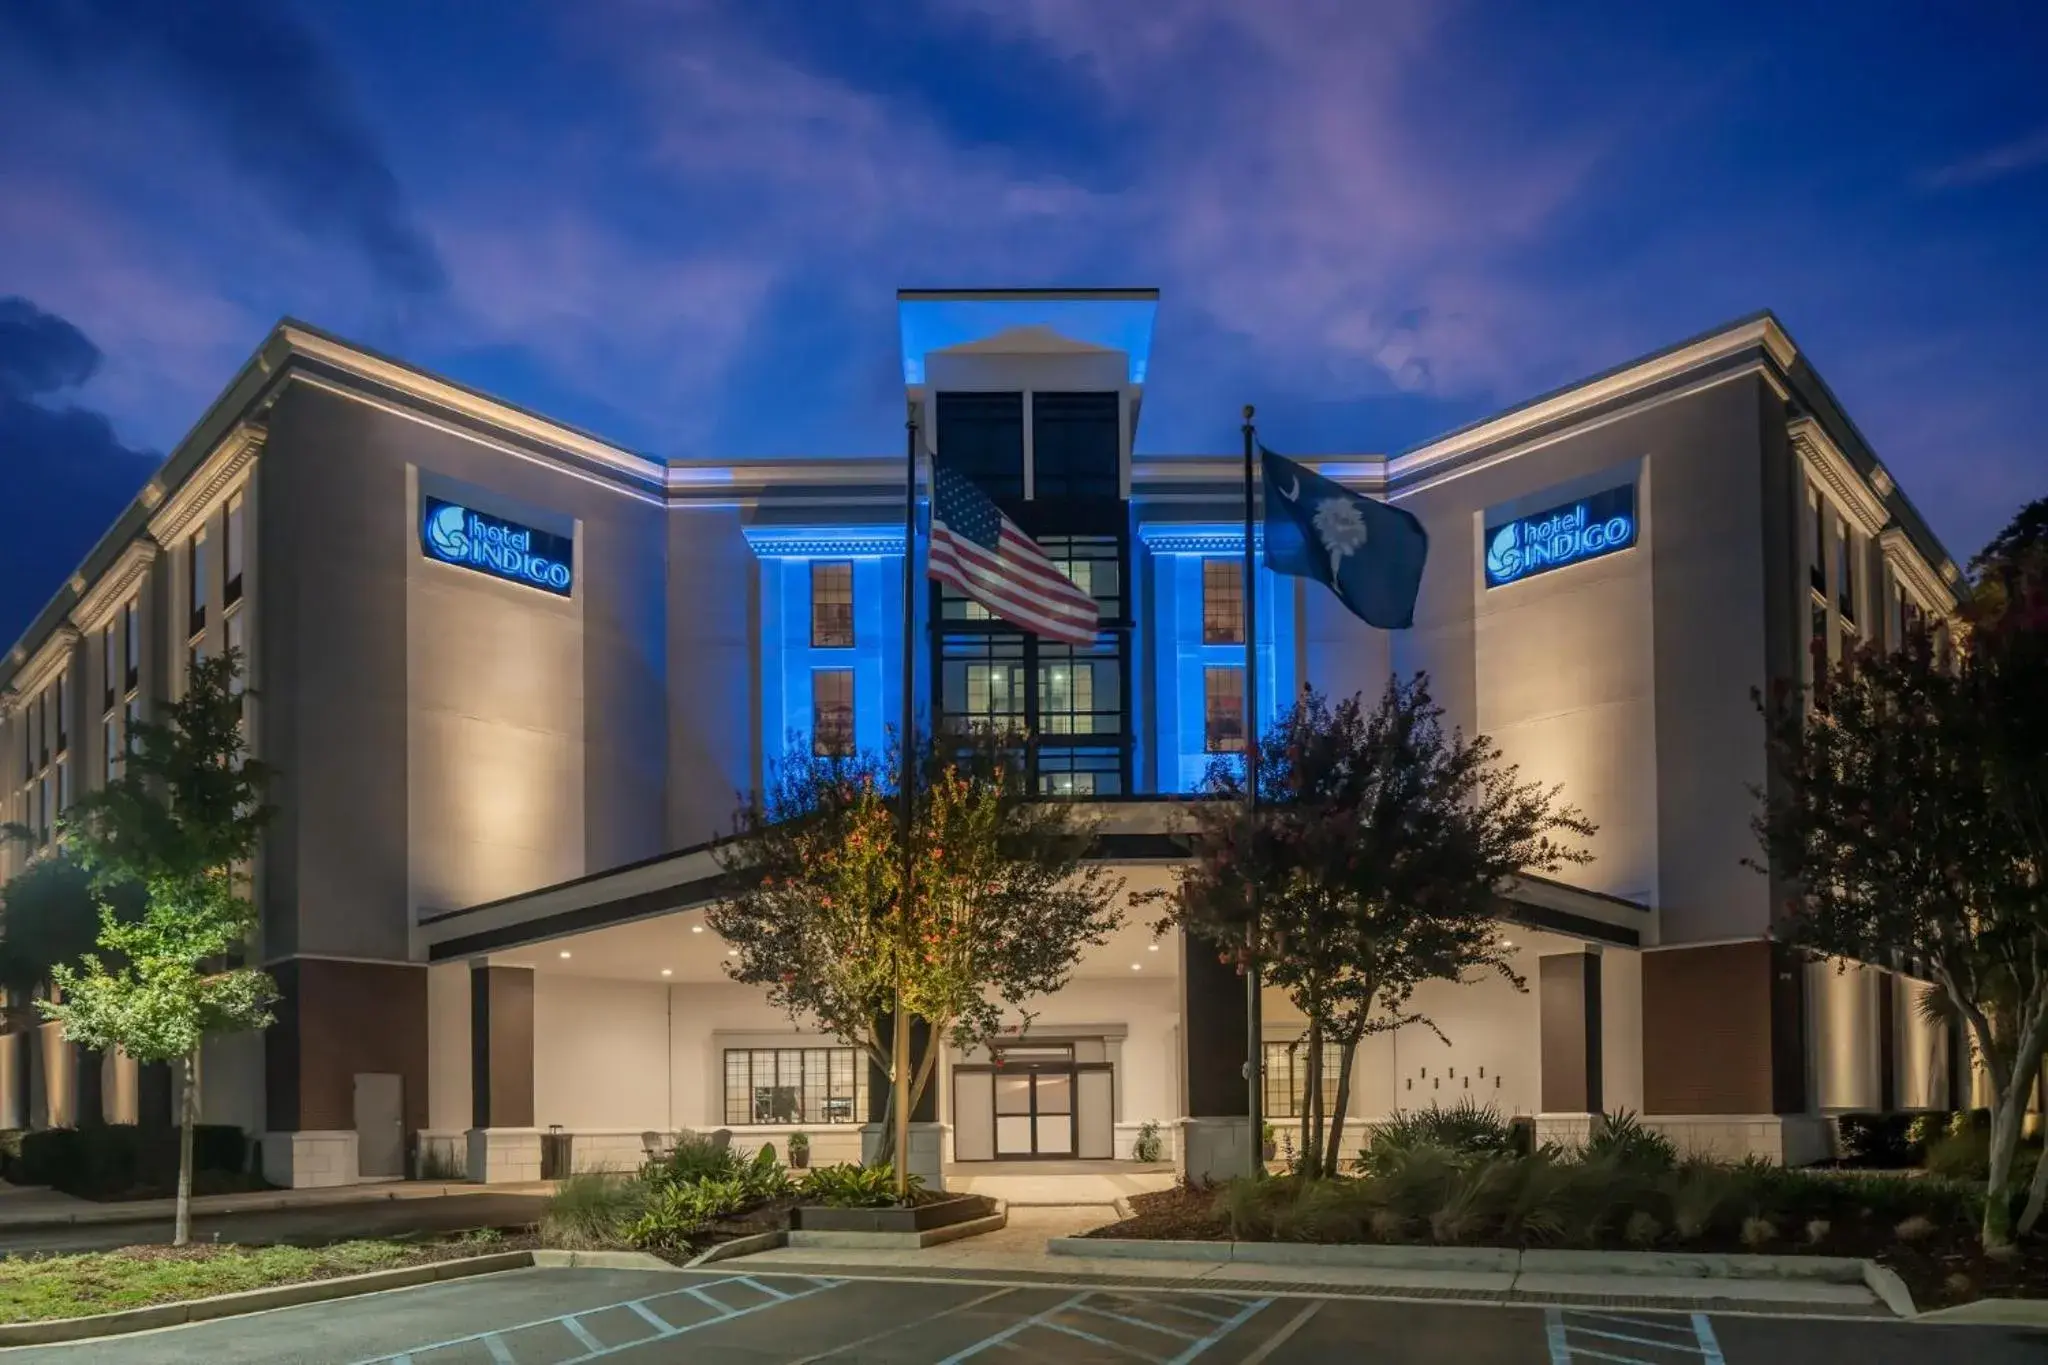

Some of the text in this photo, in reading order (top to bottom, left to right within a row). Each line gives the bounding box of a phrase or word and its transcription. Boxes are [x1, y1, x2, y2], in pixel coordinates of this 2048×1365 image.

[473, 514, 530, 551] hotel
[1524, 504, 1584, 544] hotel
[1524, 517, 1630, 567] INDIGO
[473, 538, 570, 587] INDIGO
